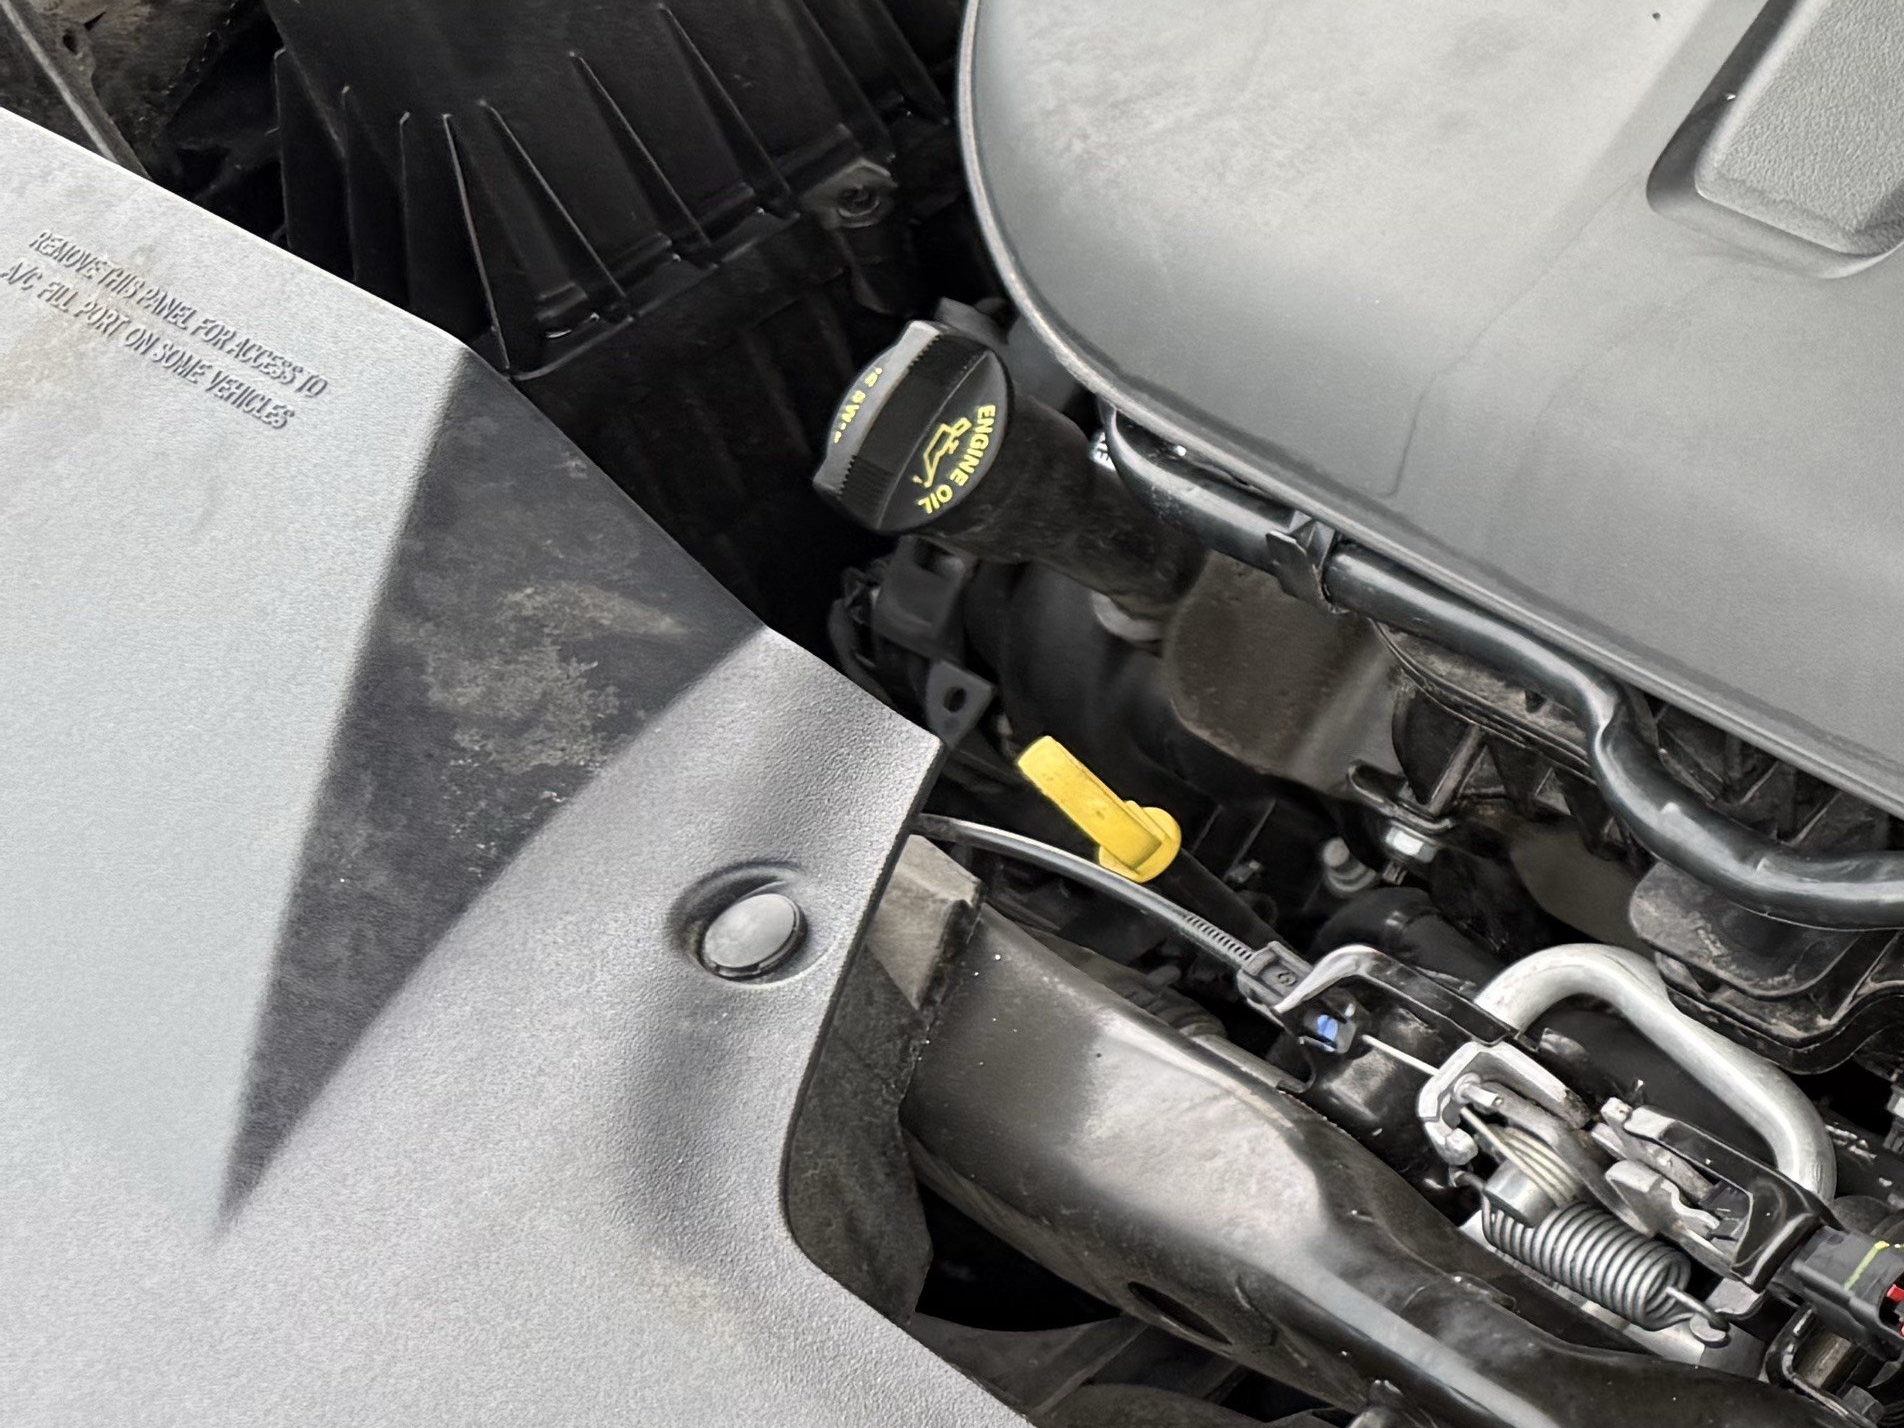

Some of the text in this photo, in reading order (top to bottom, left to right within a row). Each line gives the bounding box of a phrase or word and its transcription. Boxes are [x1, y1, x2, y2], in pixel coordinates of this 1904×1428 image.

[28, 231, 329, 399] REMOVE THIS PANEL FOR ACCESS TO
[37, 281, 79, 314] FILL
[73, 300, 132, 339] PORT
[125, 328, 161, 357] ON
[152, 342, 213, 385] SOME
[204, 370, 296, 430] VEHICLES
[917, 404, 997, 515] ENGINE OIL
